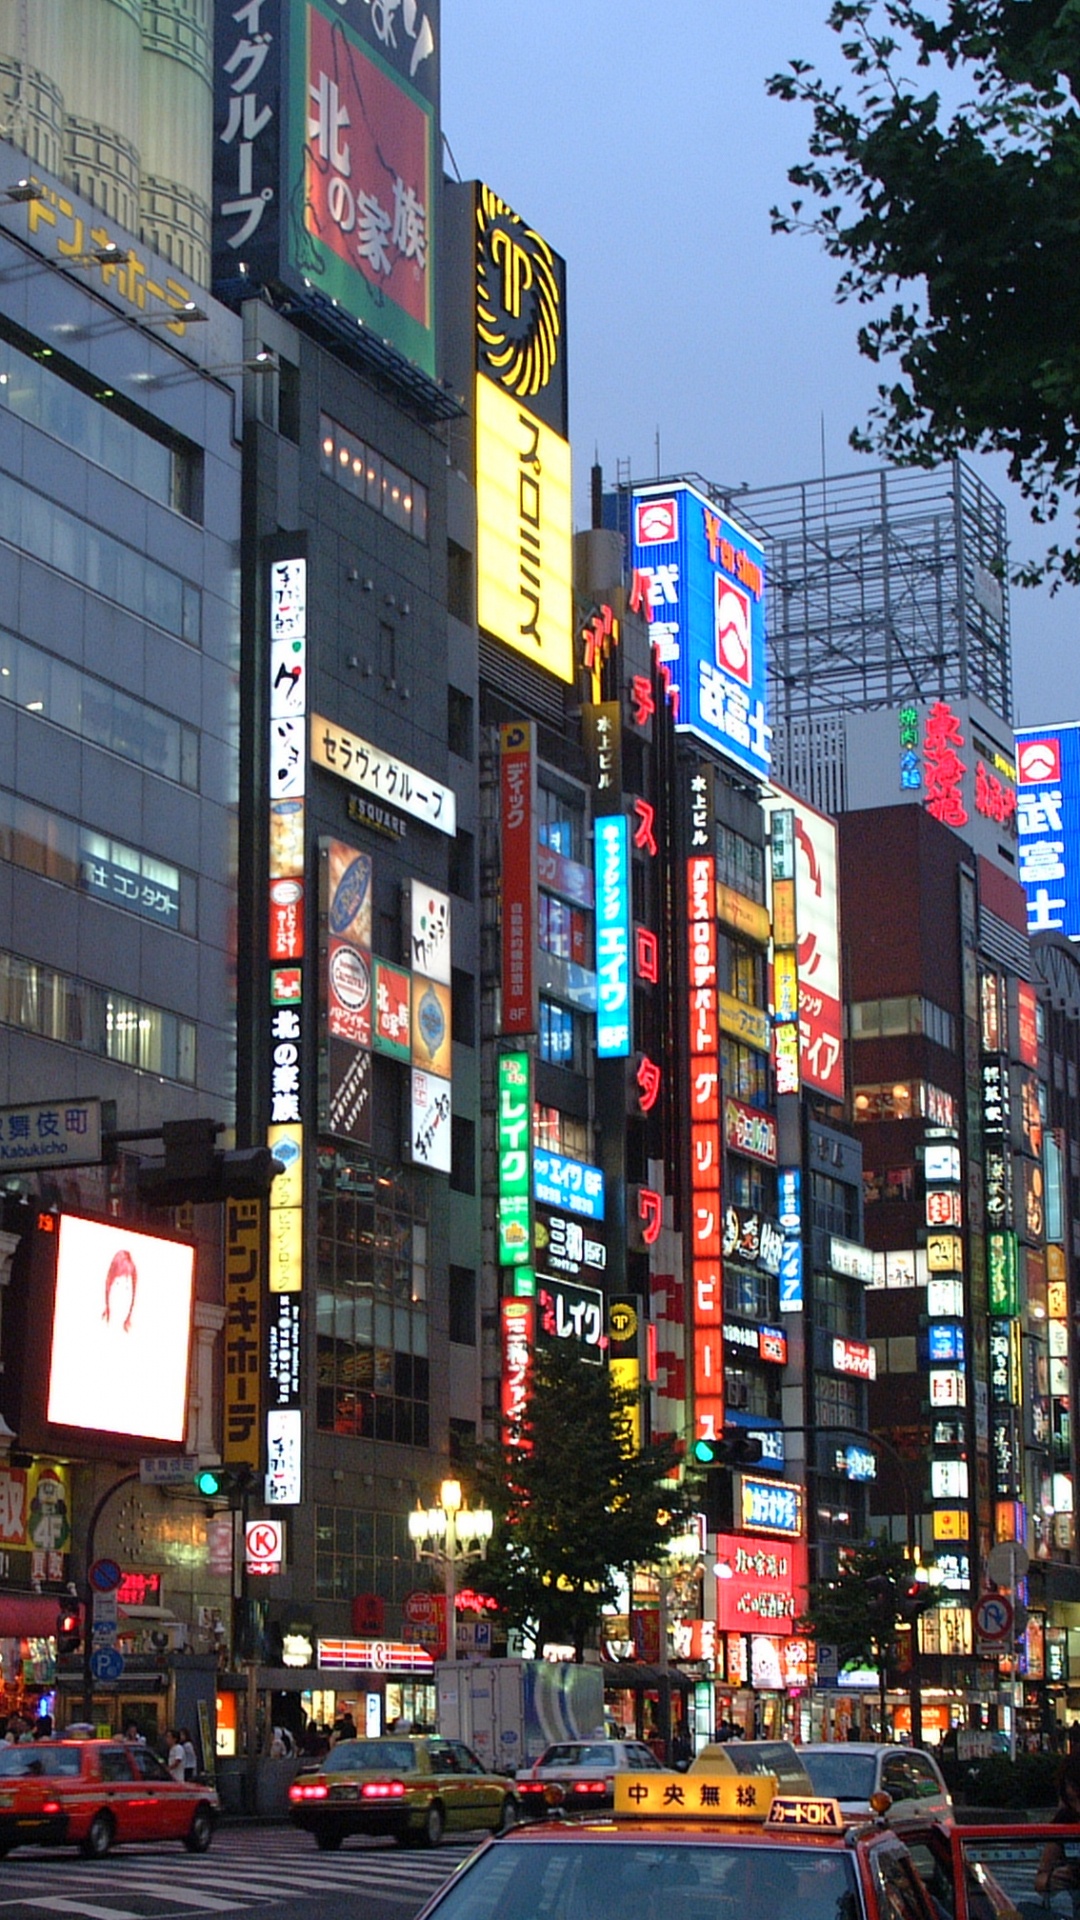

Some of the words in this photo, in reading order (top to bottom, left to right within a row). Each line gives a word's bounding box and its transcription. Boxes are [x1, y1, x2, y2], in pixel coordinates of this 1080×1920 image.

[307, 71, 427, 276] 北の家族
[519, 413, 543, 649] プロミス
[596, 715, 613, 789] 水上ビル
[699, 659, 773, 763] 武富士
[322, 728, 446, 820] セラヴィグループ
[357, 797, 407, 837] SQUARE
[507, 761, 527, 829] ディック
[690, 775, 708, 846] 水上ビル
[1017, 789, 1067, 932] 武富士
[599, 926, 627, 1013] エイワ
[692, 858, 716, 1054] パチスロのデパート
[271, 1009, 301, 1122] 北の家族
[501, 1089, 527, 1181] レイク
[549, 1157, 583, 1192] エイワ
[695, 1073, 720, 1440] グリンピース
[782, 1240, 803, 1300] 747
[227, 1205, 260, 1443] ドン・キホーテ
[556, 1294, 600, 1345] レイク
[97, 1654, 111, 1676] P
[627, 1782, 757, 1809] 中央無線
[772, 1802, 832, 1826] カードOK
